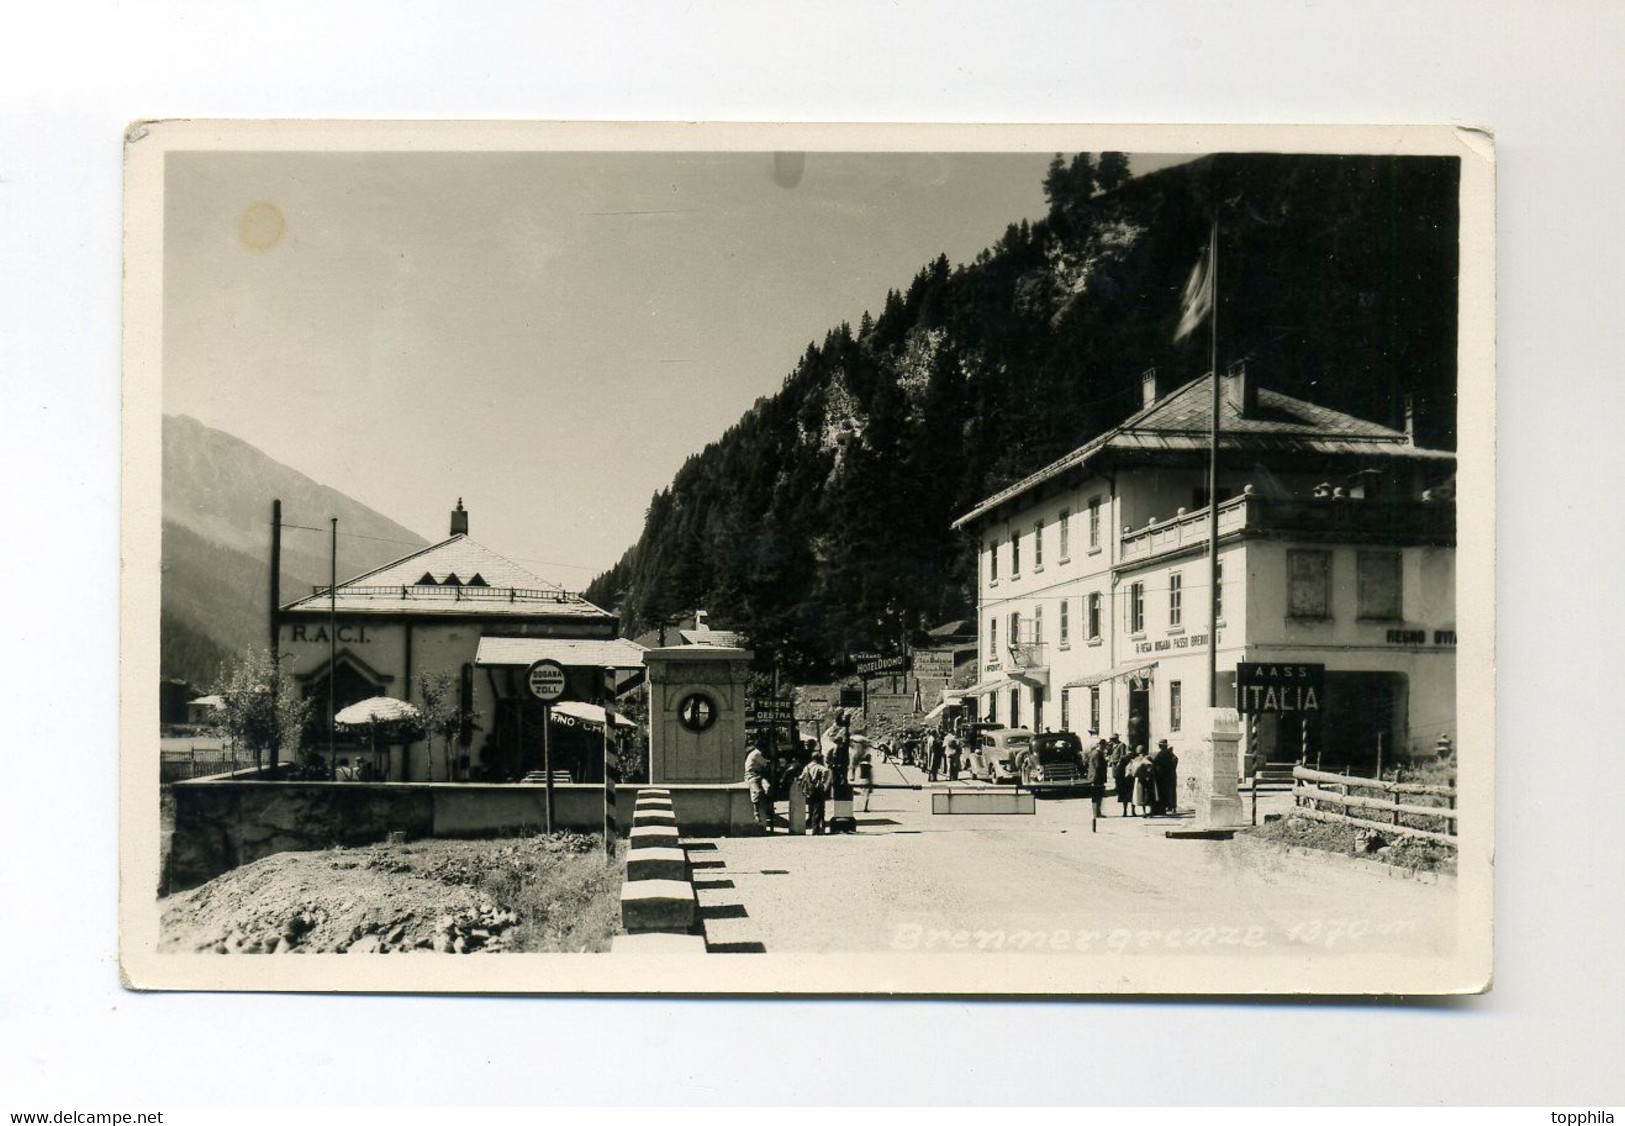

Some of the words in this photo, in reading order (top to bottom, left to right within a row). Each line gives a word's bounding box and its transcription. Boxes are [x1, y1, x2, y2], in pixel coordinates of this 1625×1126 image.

[291, 624, 371, 643] R.AC.I.
[1387, 630, 1425, 644] REGNO
[857, 660, 878, 673] HOTEL
[878, 656, 903, 669] DUOMO
[533, 670, 562, 678] DOGANA
[535, 685, 560, 694] ZOLL
[1241, 685, 1319, 711] ITALIA
